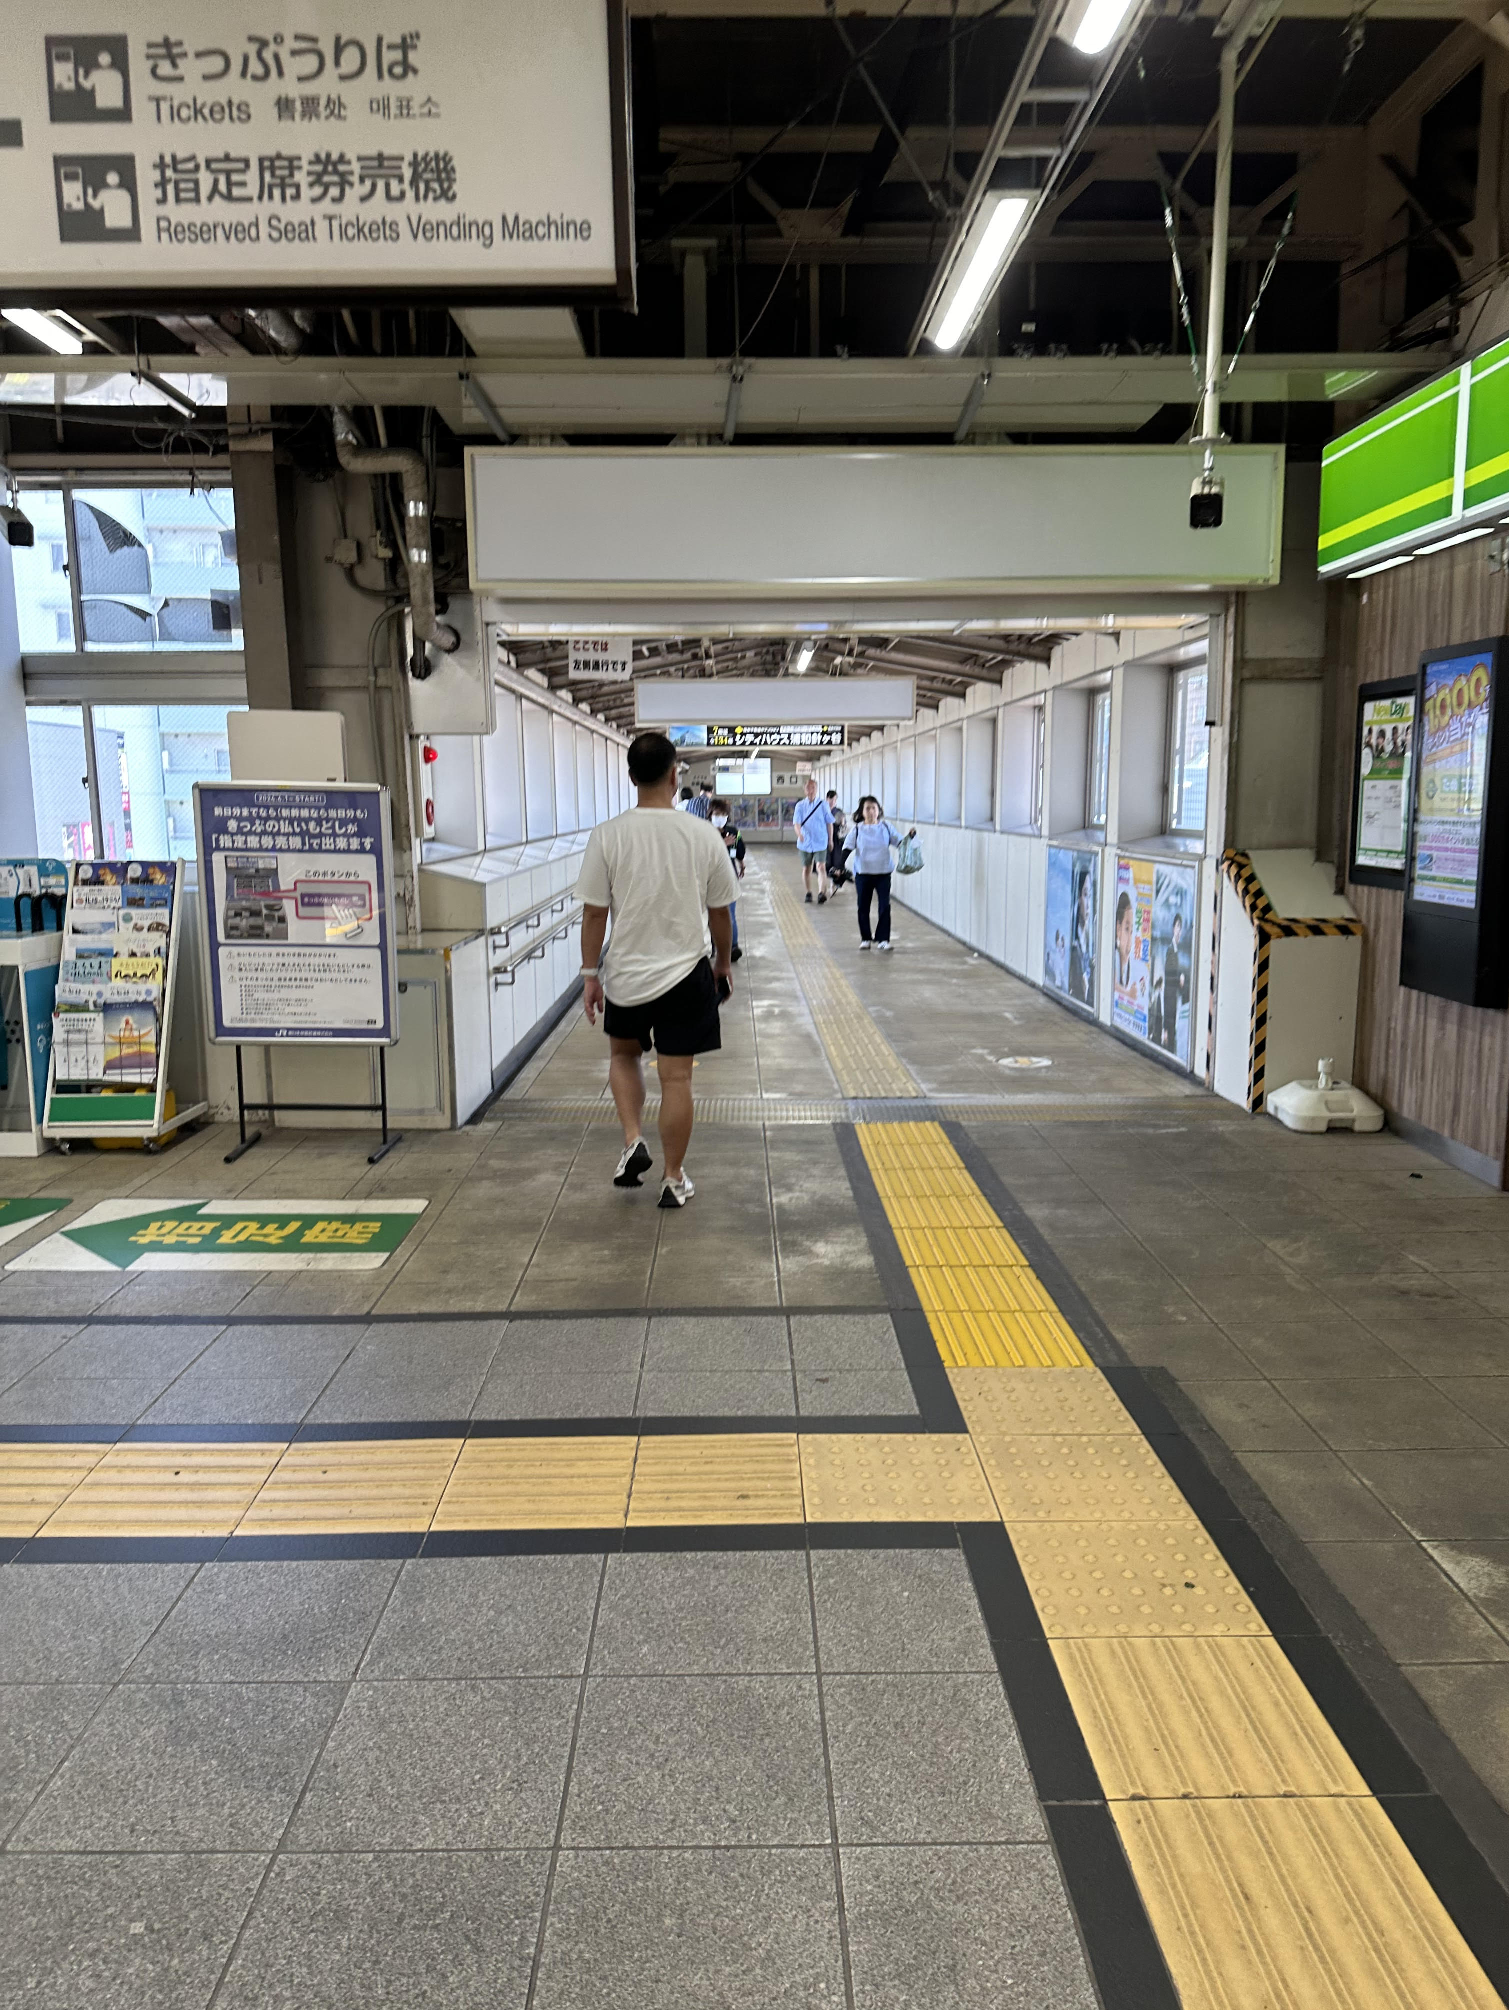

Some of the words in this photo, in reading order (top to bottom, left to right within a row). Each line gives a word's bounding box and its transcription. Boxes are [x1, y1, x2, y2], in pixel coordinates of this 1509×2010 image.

[144, 30, 422, 84] きっぷうりば
[148, 94, 253, 124] Tickets
[273, 93, 347, 123] 售票处
[368, 93, 441, 121] 매표소
[152, 150, 458, 204] 指定席券売機
[155, 214, 261, 243] Reserved
[267, 214, 317, 243] Seat
[323, 213, 401, 243] Tickets
[407, 213, 495, 249] Vending
[502, 213, 592, 243] Machine
[573, 639, 609, 652] ここでは
[573, 659, 628, 672] 左側通行です
[128, 1220, 382, 1245] 指定席
